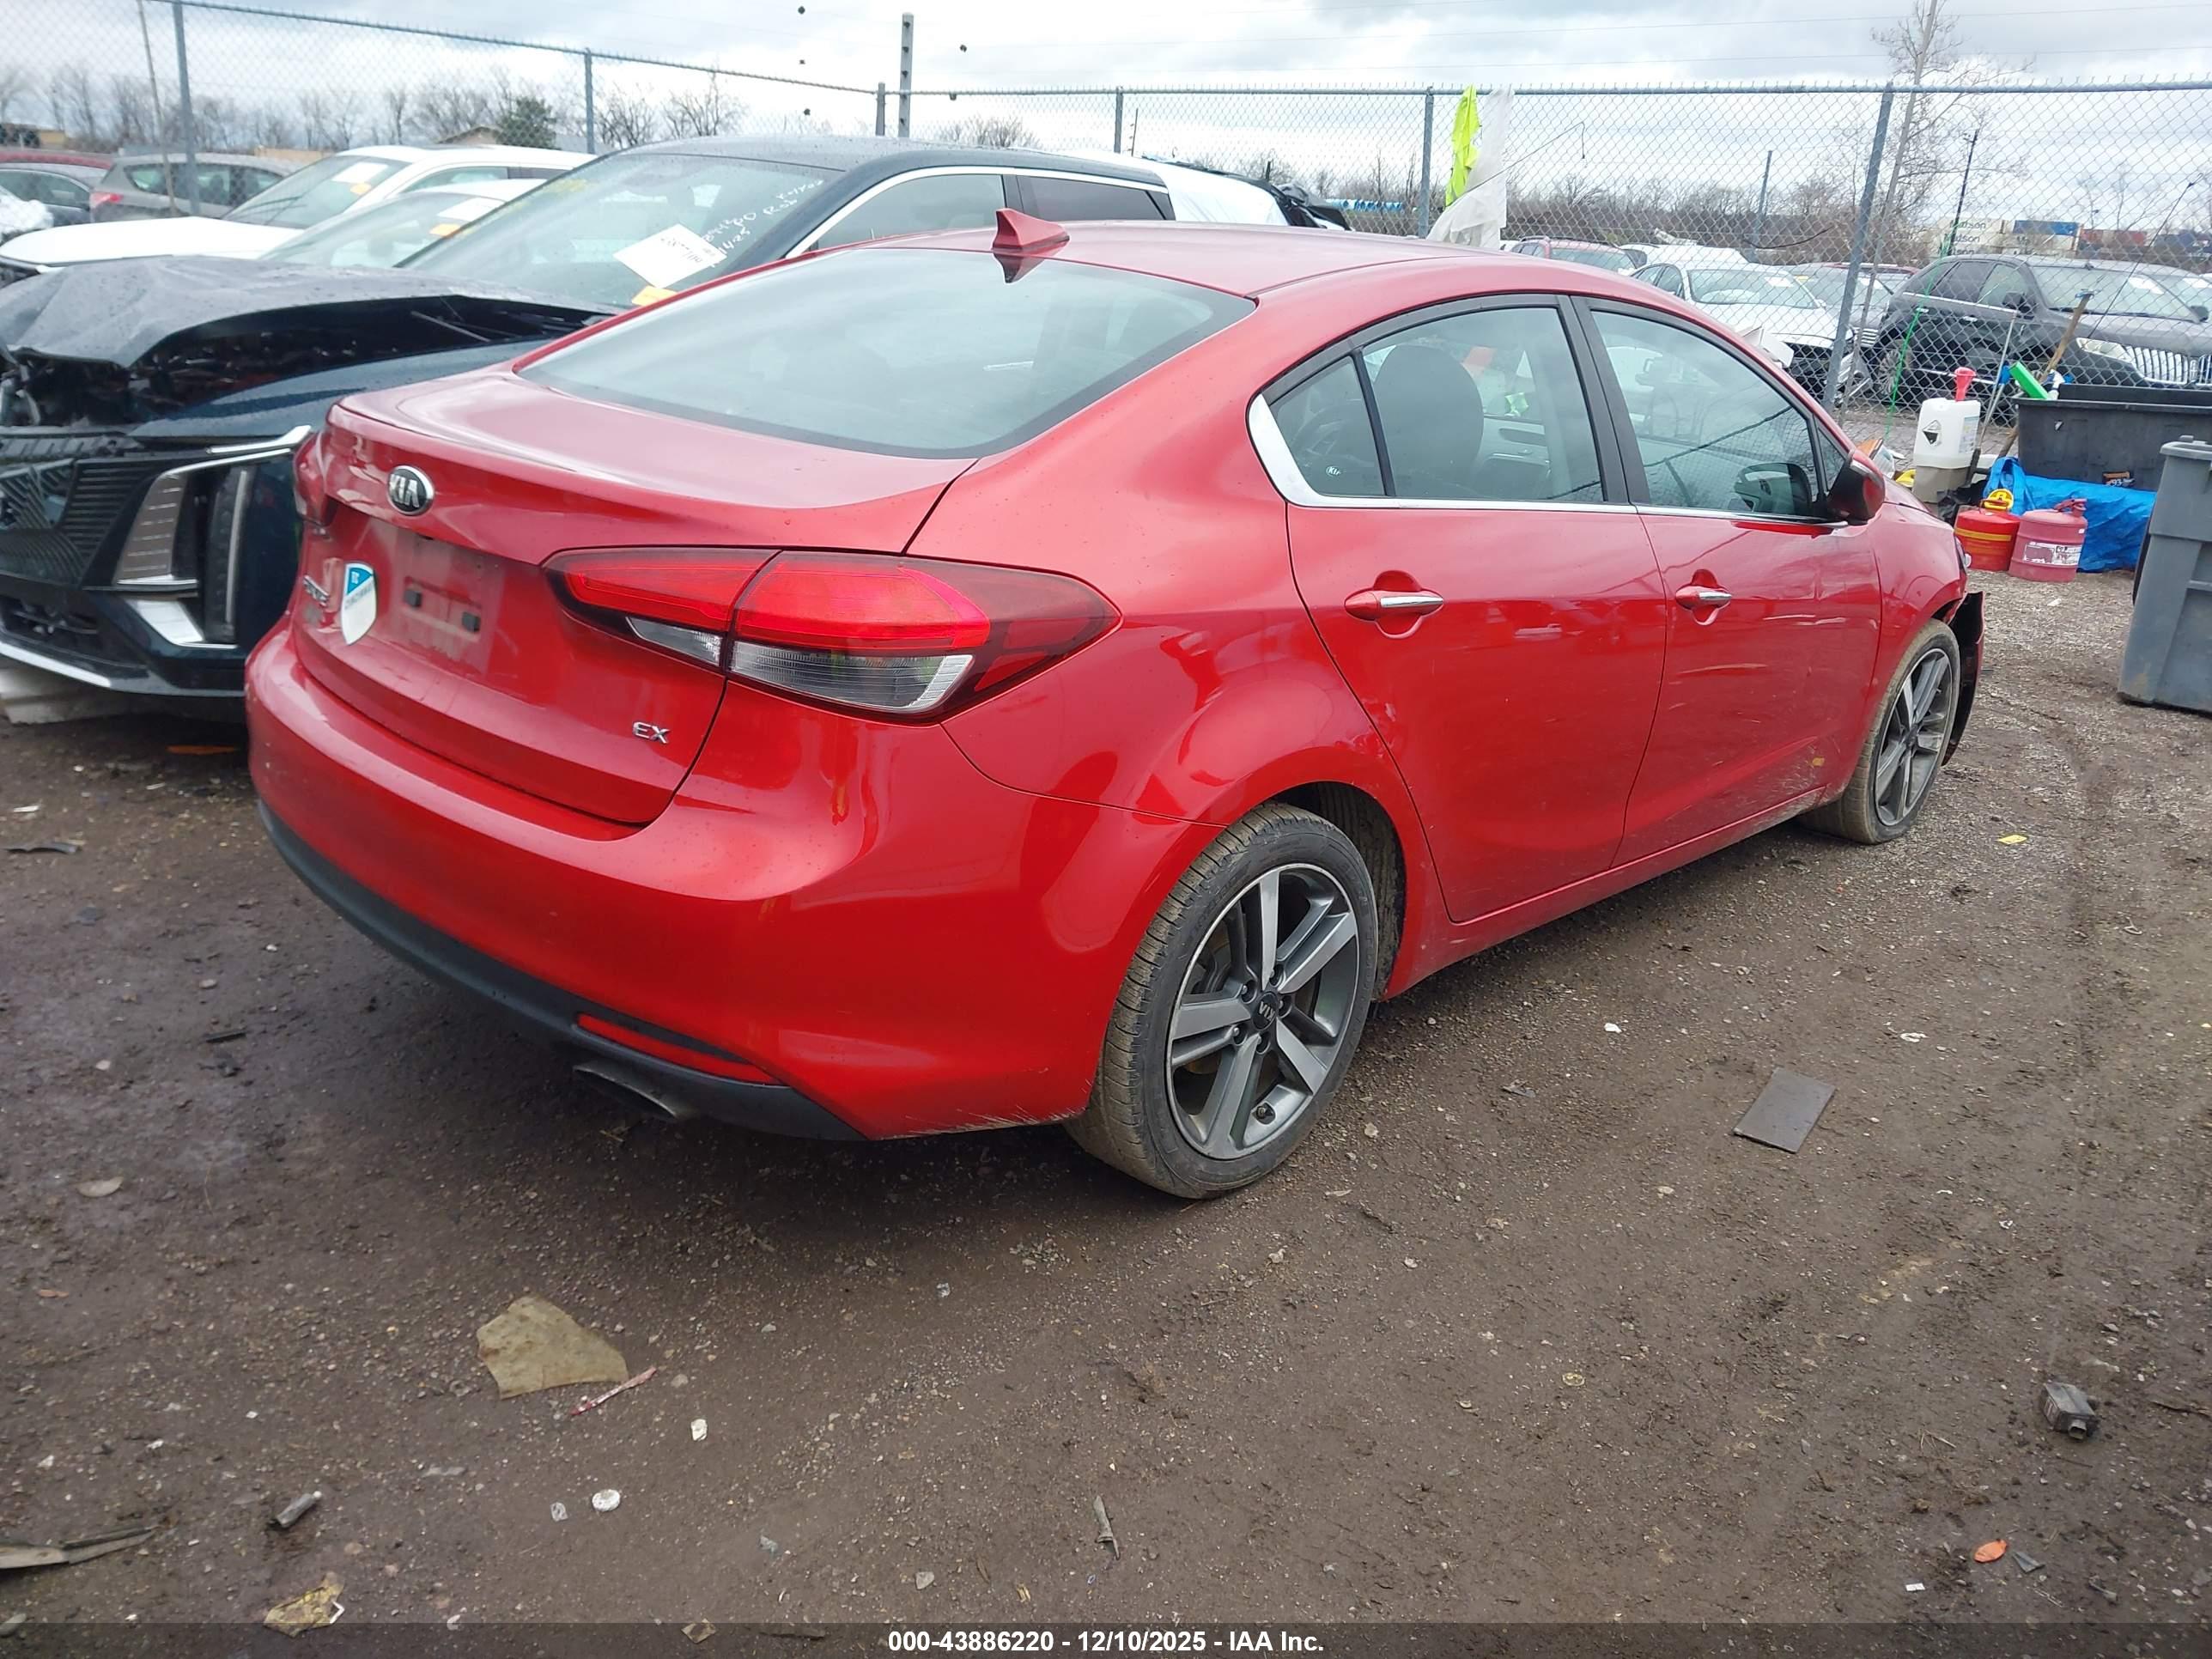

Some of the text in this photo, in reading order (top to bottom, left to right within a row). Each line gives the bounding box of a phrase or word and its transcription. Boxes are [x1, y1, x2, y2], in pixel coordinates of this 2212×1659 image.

[388, 473, 420, 507] KIA
[633, 721, 670, 744] EX
[1258, 1000, 1276, 1022] KIA
